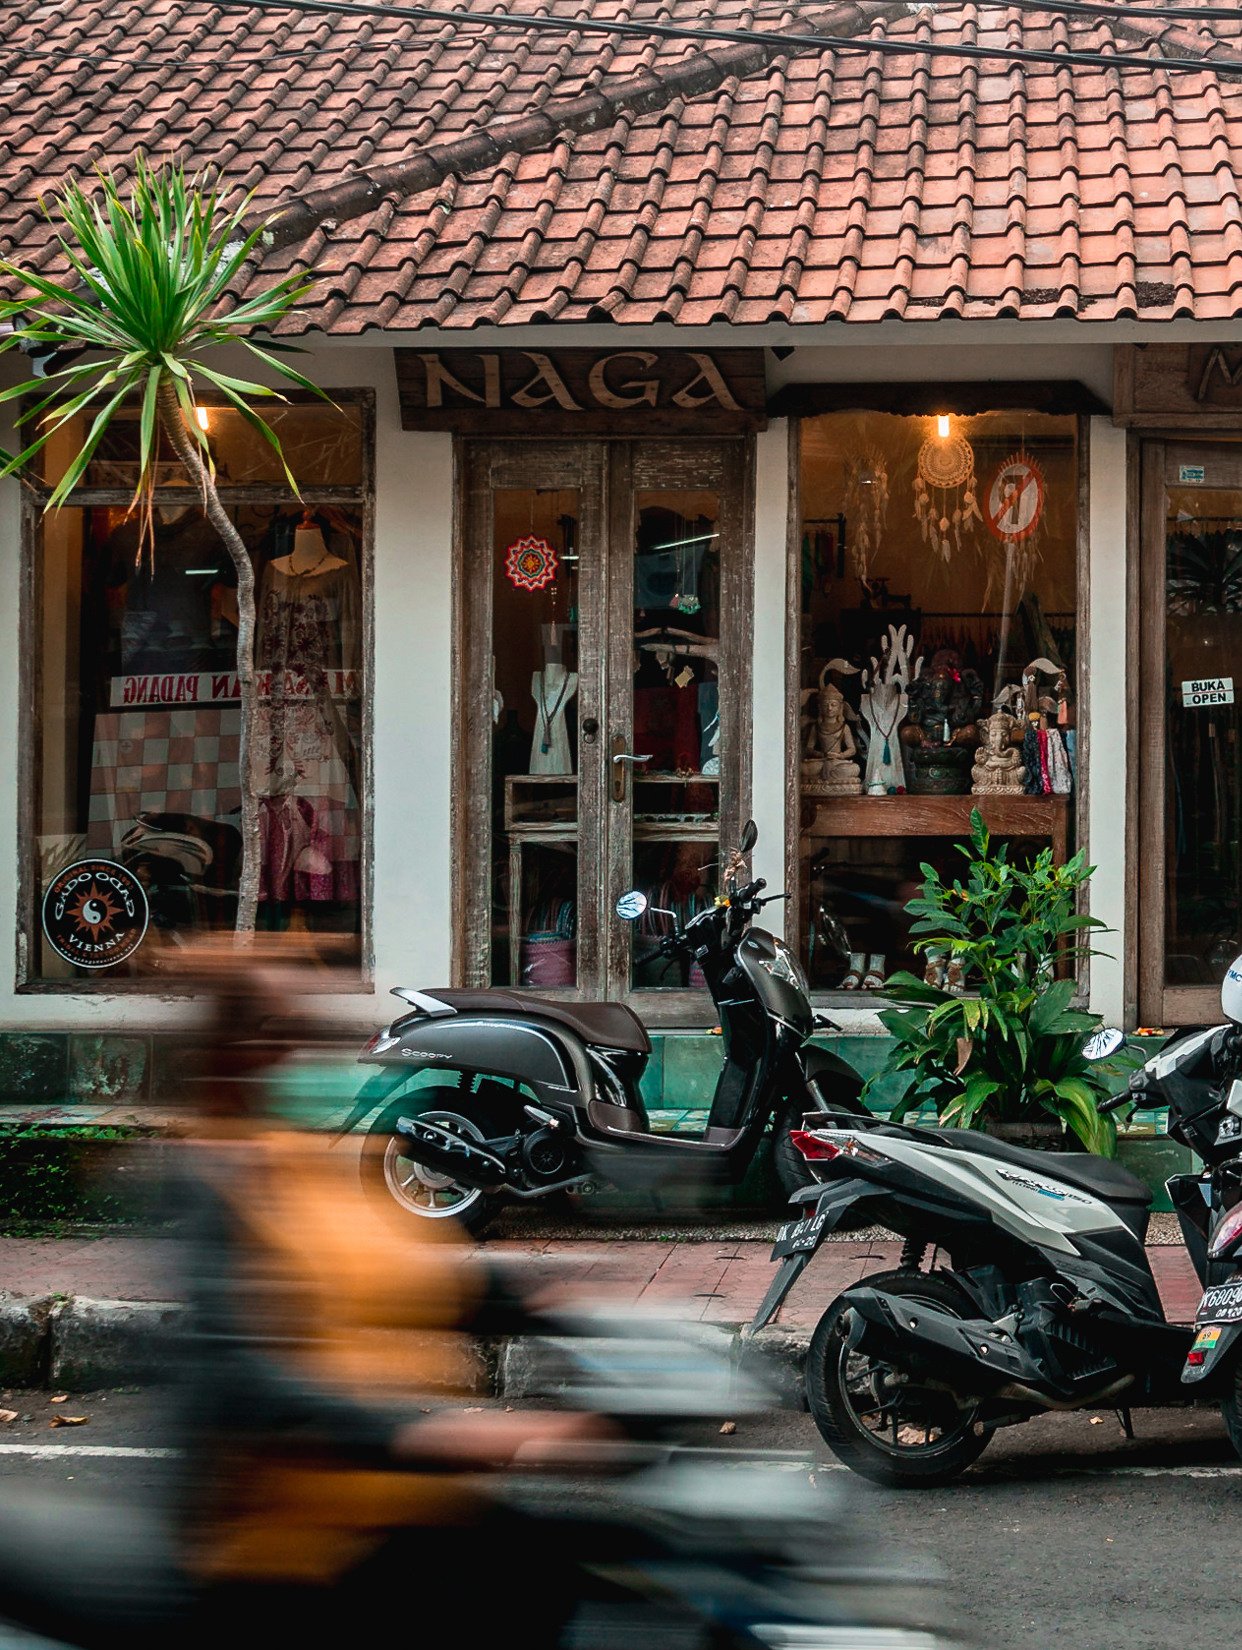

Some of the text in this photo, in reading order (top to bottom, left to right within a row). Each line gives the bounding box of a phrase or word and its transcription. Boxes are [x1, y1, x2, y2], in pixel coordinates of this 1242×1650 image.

[416, 351, 746, 412] NAGA
[1191, 680, 1225, 692] BUKA
[1192, 692, 1227, 705] OPEN
[68, 932, 125, 952] VIENNA
